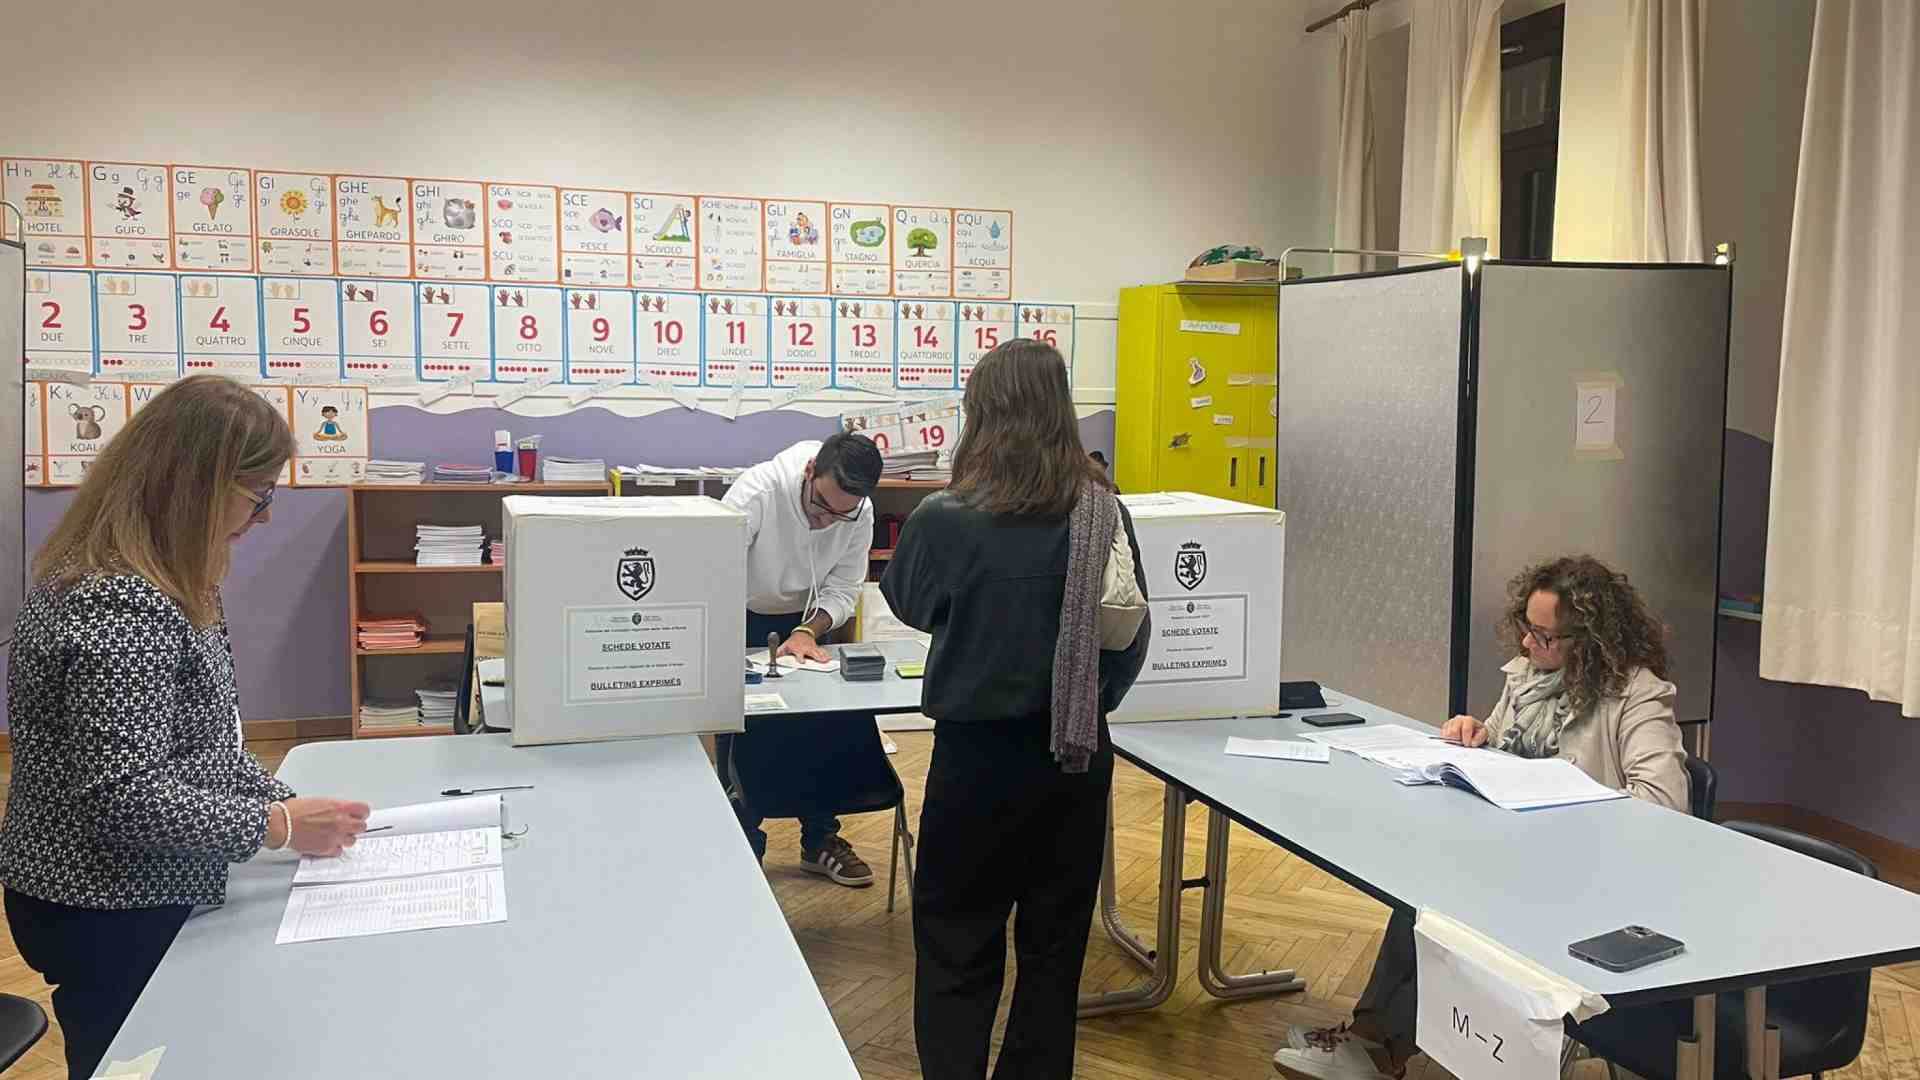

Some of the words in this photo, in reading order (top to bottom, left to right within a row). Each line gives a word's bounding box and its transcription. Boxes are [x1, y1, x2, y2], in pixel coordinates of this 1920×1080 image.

[7, 163, 18, 177] H
[93, 166, 106, 180] G
[112, 172, 120, 183] g
[176, 172, 196, 183] GE
[260, 177, 273, 190] GI
[339, 181, 369, 193] GHE
[176, 191, 190, 200] ge
[415, 185, 440, 197] GHI
[491, 187, 511, 197] SCA
[339, 196, 359, 206] ghe
[564, 193, 588, 206] SCE
[634, 198, 653, 210] SCI
[768, 205, 786, 216] GLI
[833, 208, 851, 219] GN
[896, 210, 907, 224] Q
[957, 214, 982, 226] CQU
[27, 223, 62, 232] HOTEL
[115, 225, 146, 235] GUFO
[193, 222, 232, 232] GELATO
[270, 228, 320, 237] GIRASOLE
[346, 231, 400, 240] GHEPARDO
[433, 234, 464, 243] GHIRO
[580, 242, 608, 250] PESCE
[645, 246, 682, 254] SCIVOLO
[845, 253, 878, 261] STAGNO
[969, 257, 996, 266] ACQUA
[905, 260, 940, 268] QUERCIA
[42, 302, 62, 328] 2
[128, 304, 147, 330] 3
[210, 307, 230, 332] 4
[293, 308, 311, 333] 5
[370, 310, 388, 335] 6
[447, 313, 464, 336] 7
[520, 315, 538, 339] 8
[592, 318, 609, 341] 9
[654, 321, 683, 344] 10
[726, 321, 745, 343] 11
[788, 323, 814, 346] 12
[41, 333, 64, 342] DUE
[129, 335, 148, 343] TRE
[196, 336, 246, 345] QUATTRO
[852, 325, 876, 347] 13
[914, 326, 938, 348] 14
[975, 328, 998, 349] 15
[282, 337, 321, 347] CINQUE
[442, 341, 469, 350] SETTE
[517, 343, 542, 352] OTTO
[589, 345, 614, 354] NOVE
[722, 348, 752, 356] UNDICI
[787, 350, 816, 358] DODICI
[850, 350, 880, 358] TREDICI
[900, 351, 952, 360] QUATTORDICI
[50, 386, 62, 399] K
[66, 389, 72, 399] k
[134, 388, 151, 400] W
[298, 390, 308, 403] Y
[312, 396, 318, 407] y
[1584, 395, 1608, 424] 2
[920, 425, 945, 447] 19
[70, 443, 103, 452] KOAL
[318, 445, 346, 453] YOGA
[1162, 628, 1190, 637] SCHEDE
[1192, 627, 1218, 635] VOTATE
[602, 643, 637, 653] SCHEDE
[639, 641, 671, 650] VOTATE
[1152, 661, 1190, 671] BULLETINS
[591, 681, 637, 691] BULLETINS
